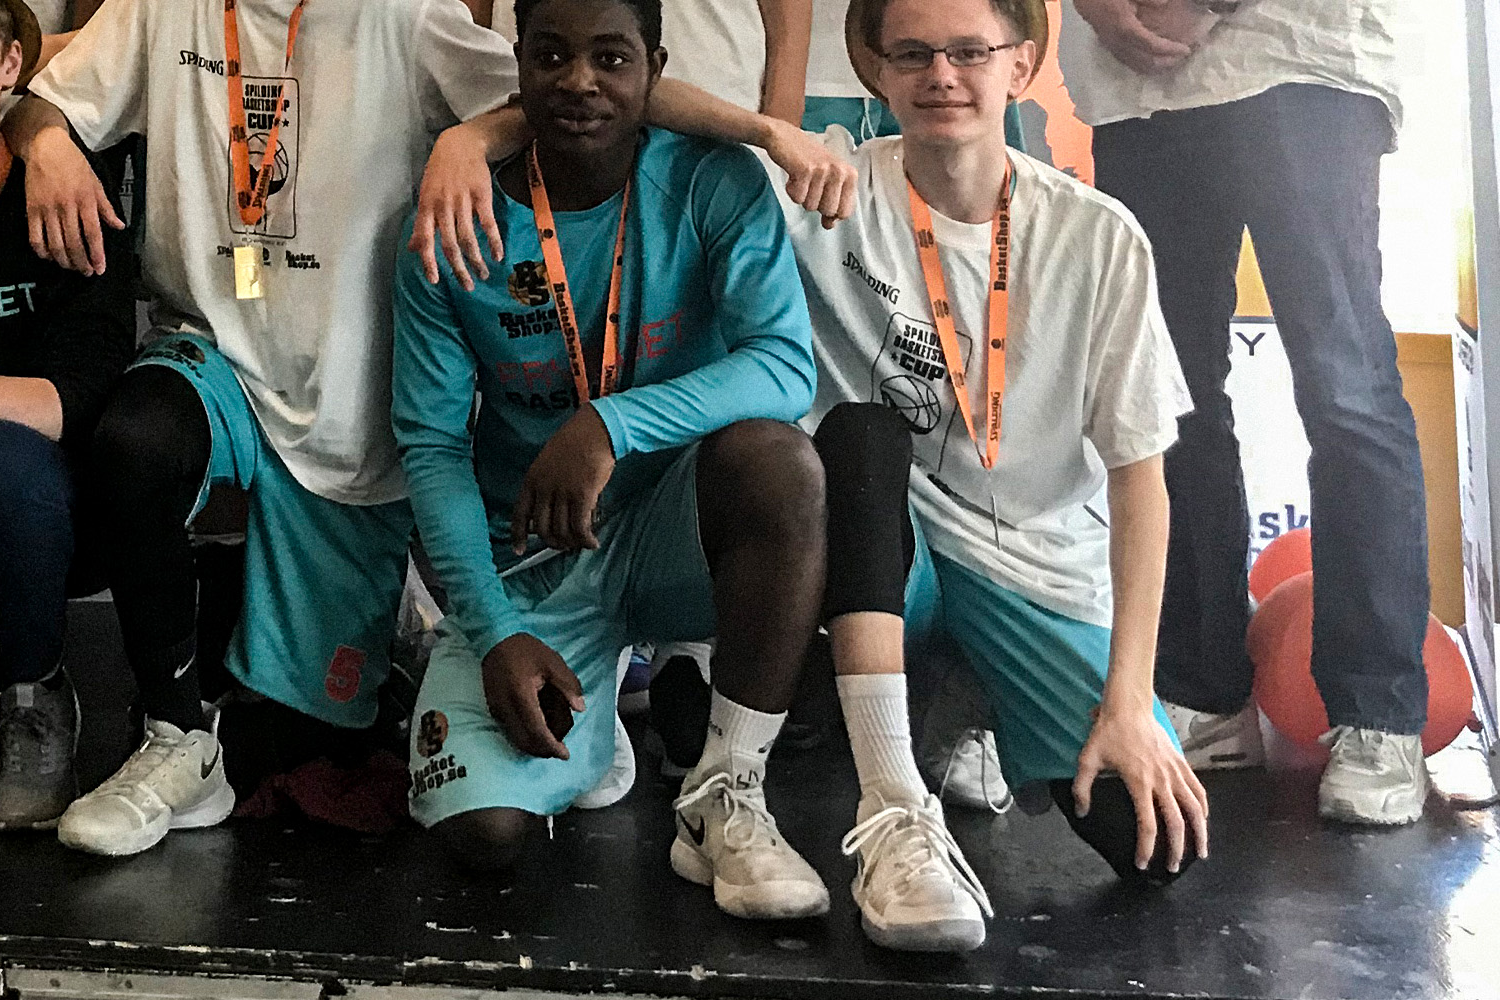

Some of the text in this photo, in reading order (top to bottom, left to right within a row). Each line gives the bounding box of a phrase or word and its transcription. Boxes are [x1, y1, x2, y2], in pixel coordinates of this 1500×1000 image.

[842, 251, 901, 305] SPALDING
[498, 309, 558, 328] Baske
[899, 353, 945, 382] CUP
